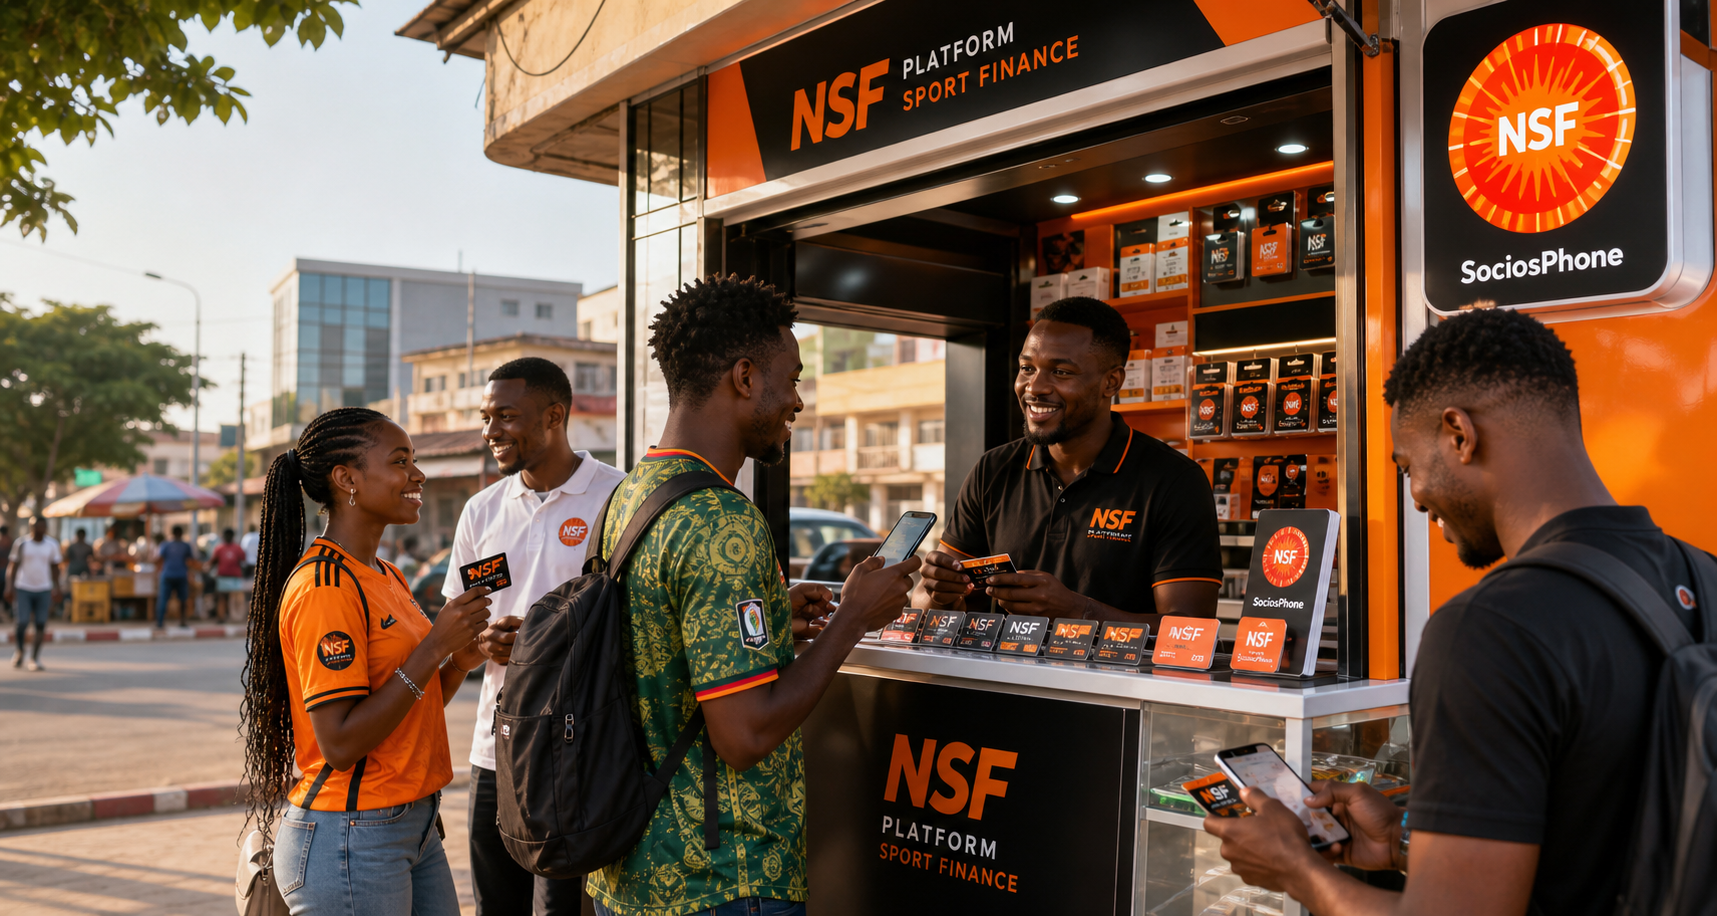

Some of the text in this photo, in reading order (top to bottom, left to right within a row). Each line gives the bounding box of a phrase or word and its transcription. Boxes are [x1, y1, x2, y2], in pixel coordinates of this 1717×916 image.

[903, 22, 1014, 80] PLATFORM
[903, 35, 1079, 111] SPORT FINANCE
[790, 57, 890, 151] NSF
[1498, 101, 1579, 157] NSF
[1460, 247, 1624, 284] SociosPhone
[1089, 508, 1137, 530] NSF
[562, 525, 587, 537] NSF
[1273, 549, 1298, 564] NSF
[468, 557, 504, 580] NSF
[1252, 597, 1304, 609] SociosPhone
[930, 615, 957, 627] NSF
[969, 618, 996, 631] NSF
[1009, 621, 1040, 634] NSF
[1055, 623, 1092, 638] NSF
[1104, 626, 1143, 643] NSF
[1169, 625, 1204, 641] NSF
[1246, 631, 1274, 648] NSF
[320, 638, 350, 657] NSF
[883, 733, 1019, 821] NSF
[882, 815, 997, 860] PLATFORM
[879, 842, 1018, 893] SPORT FINANCE
